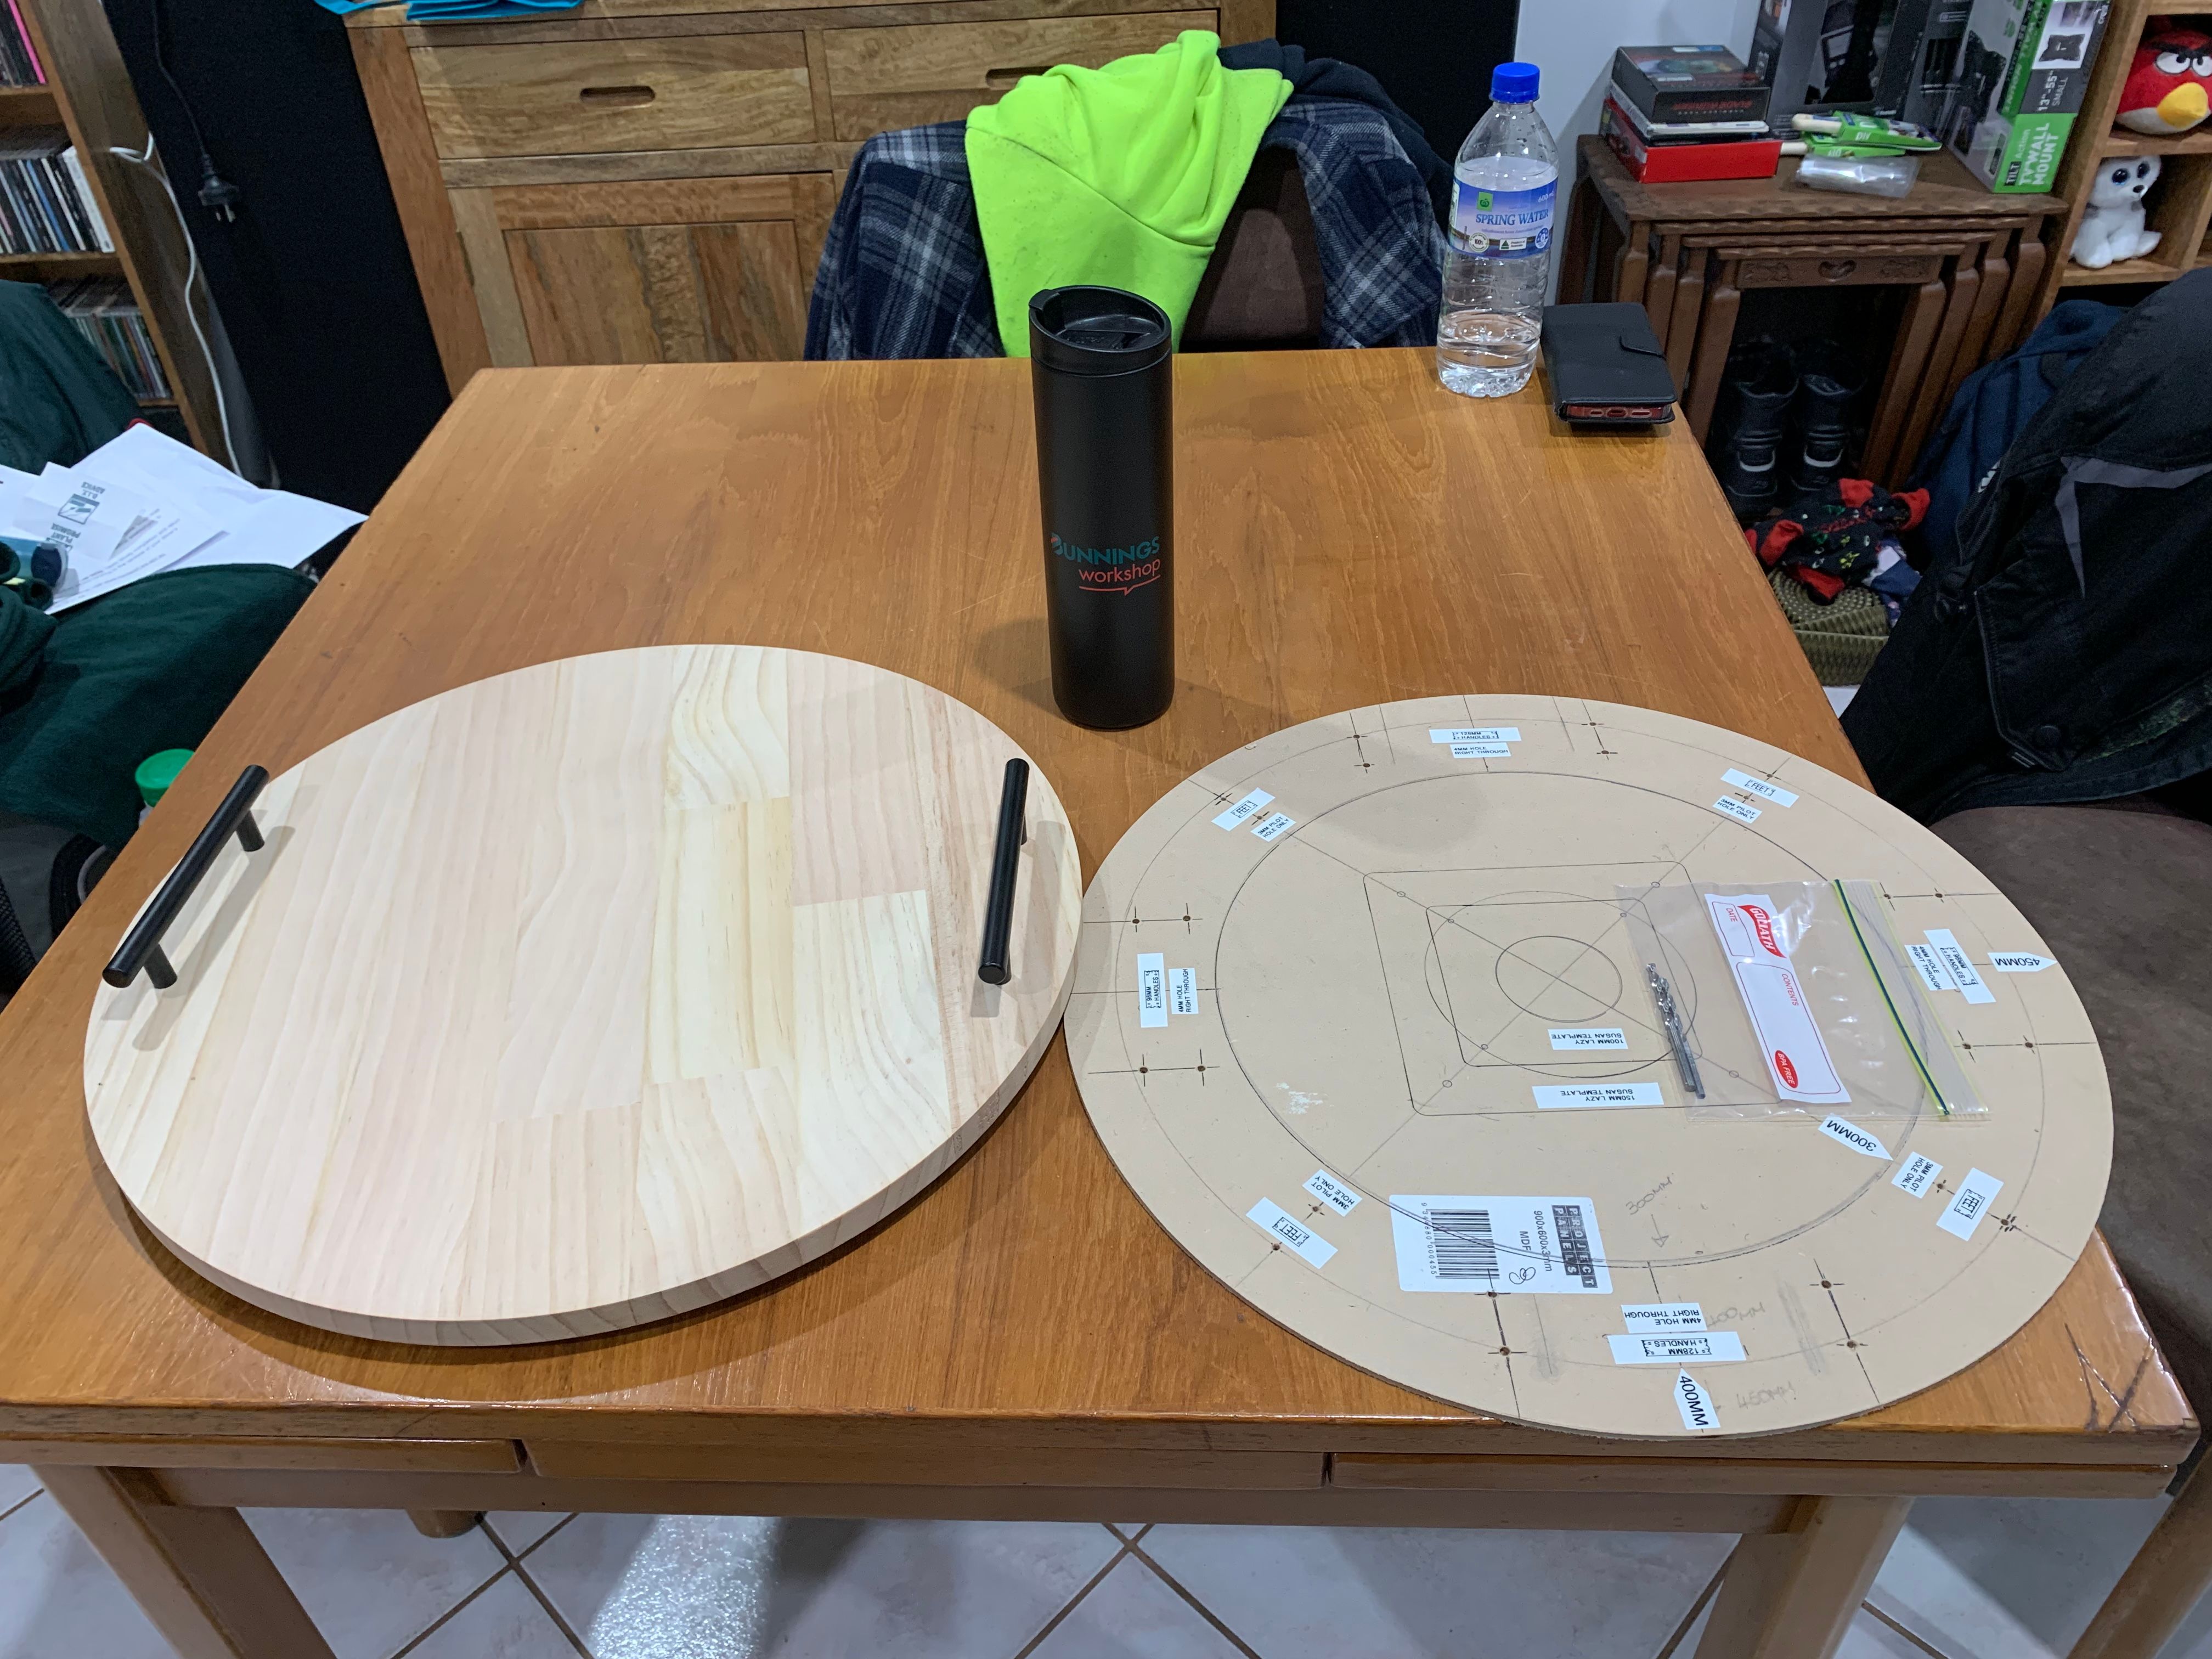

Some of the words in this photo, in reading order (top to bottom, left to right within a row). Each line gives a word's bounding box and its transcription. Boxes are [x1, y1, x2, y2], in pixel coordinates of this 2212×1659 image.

[2051, 77, 2068, 106] SMALL
[2026, 122, 2050, 162] WALL
[2032, 134, 2059, 184] MOUNT
[2006, 164, 2020, 184] TILT
[2019, 161, 2035, 185] TV
[1538, 194, 1548, 202] 600
[1476, 213, 1515, 225] SPRING
[1518, 209, 1549, 225] WATER
[1051, 532, 1160, 565] BUNNINGS
[1079, 558, 1161, 583] workshop
[1751, 782, 1769, 792] FEET
[1236, 804, 1252, 815] FEET
[1717, 802, 1735, 812] HOLE
[1736, 810, 1754, 819] ONLY
[1720, 798, 1735, 806] 3MM
[1736, 805, 1756, 815] PILOT
[1257, 826, 1269, 835] 3MM
[1268, 816, 1283, 827] PILOT
[1262, 828, 1277, 838] HOLE
[1276, 819, 1289, 830] ONLY
[1726, 909, 1738, 922] DATE
[1750, 908, 1776, 950] GOLIATH
[1911, 946, 1925, 962] RIGHT
[1922, 964, 1943, 990] THROUGH
[1919, 946, 1929, 958] 4MM
[1927, 958, 1940, 973] HOLE
[1946, 954, 1965, 979] HANDLES
[1953, 953, 1967, 968] 96MM
[1782, 974, 1798, 1006] CONTENTS
[1778, 1053, 1787, 1066] BPA
[1784, 1066, 1795, 1085] FREE
[1826, 1120, 1877, 1152] 300MM
[1910, 1157, 1925, 1173] HOLE
[1921, 1161, 1934, 1175] 3MM
[1311, 1182, 1332, 1198] PILOT
[1314, 1176, 1334, 1190] ONLY
[1900, 1173, 1914, 1189] ONLY
[1912, 1175, 1925, 1192] PILOT
[1333, 1197, 1350, 1210] 3MM
[1334, 1189, 1355, 1205] HOLE
[1961, 1194, 1980, 1213] FEET
[1279, 1223, 1302, 1241] FEET
[1519, 1231, 1532, 1251] MDF
[1533, 1210, 1553, 1272] 900x600x3mm
[1552, 1205, 1579, 1275] PANELS
[1567, 1205, 1597, 1288] PROJECT
[1679, 1376, 1709, 1426] 400MM
